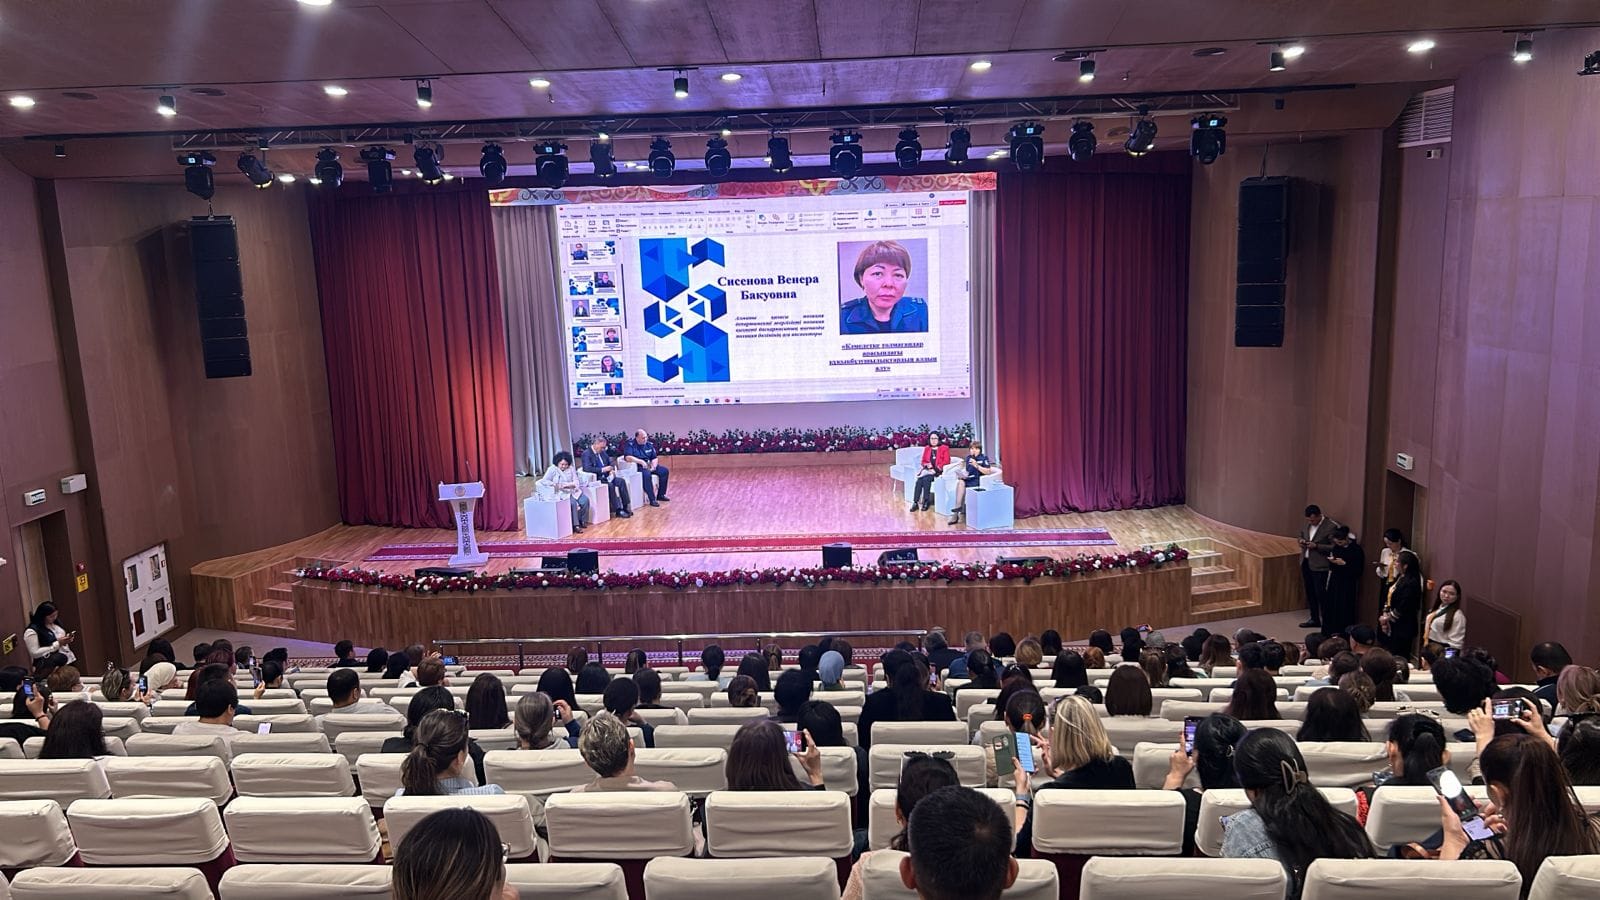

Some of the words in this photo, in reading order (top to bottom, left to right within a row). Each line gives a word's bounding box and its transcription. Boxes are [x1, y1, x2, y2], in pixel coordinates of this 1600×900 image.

[717, 276, 774, 286] Сисенова
[777, 275, 819, 286] Венера
[741, 290, 797, 301] Бакуовна
